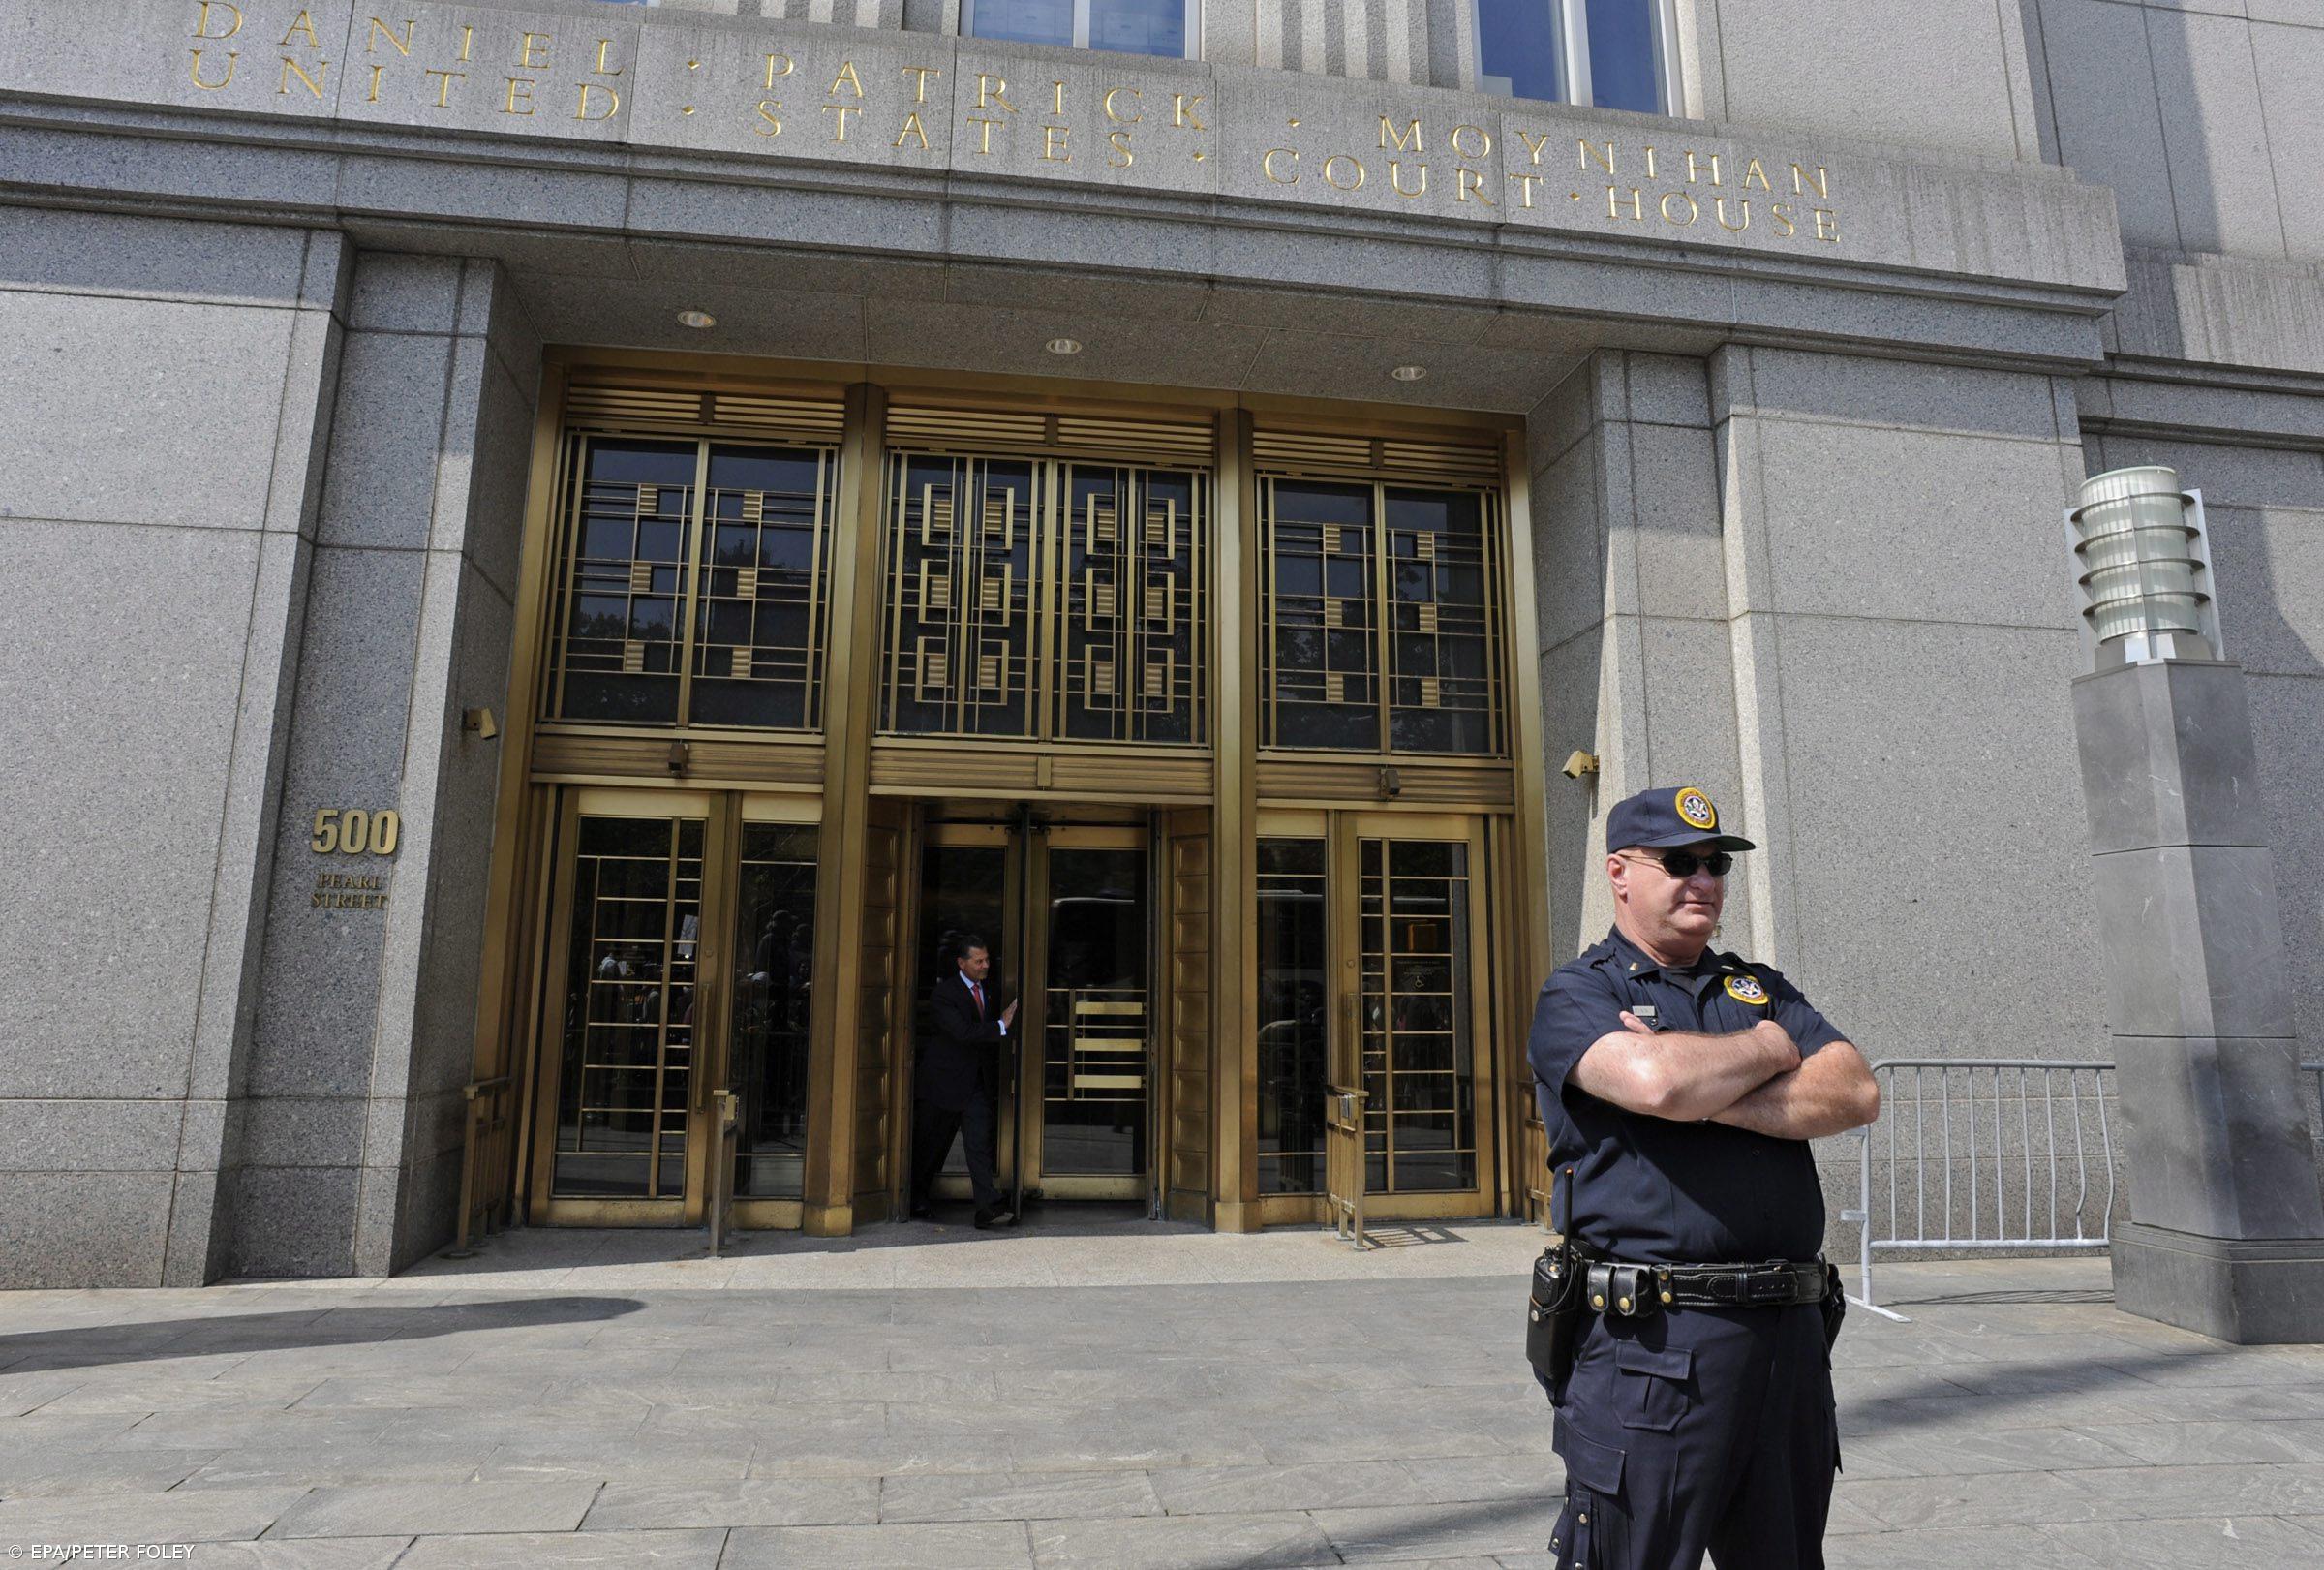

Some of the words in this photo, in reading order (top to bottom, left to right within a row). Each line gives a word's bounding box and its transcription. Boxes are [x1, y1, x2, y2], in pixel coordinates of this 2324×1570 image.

[191, 1, 626, 76] DANIEL
[763, 53, 1208, 131] PATRICK
[1376, 115, 1828, 200] MOYNIHAN
[189, 49, 620, 121] UNITED
[754, 100, 1134, 168] STATES
[1263, 148, 1544, 208] COURT
[1606, 185, 1840, 243] HOUSE
[311, 809, 400, 855] 500
[310, 892, 388, 908] STREET
[318, 873, 382, 889] PEARL
